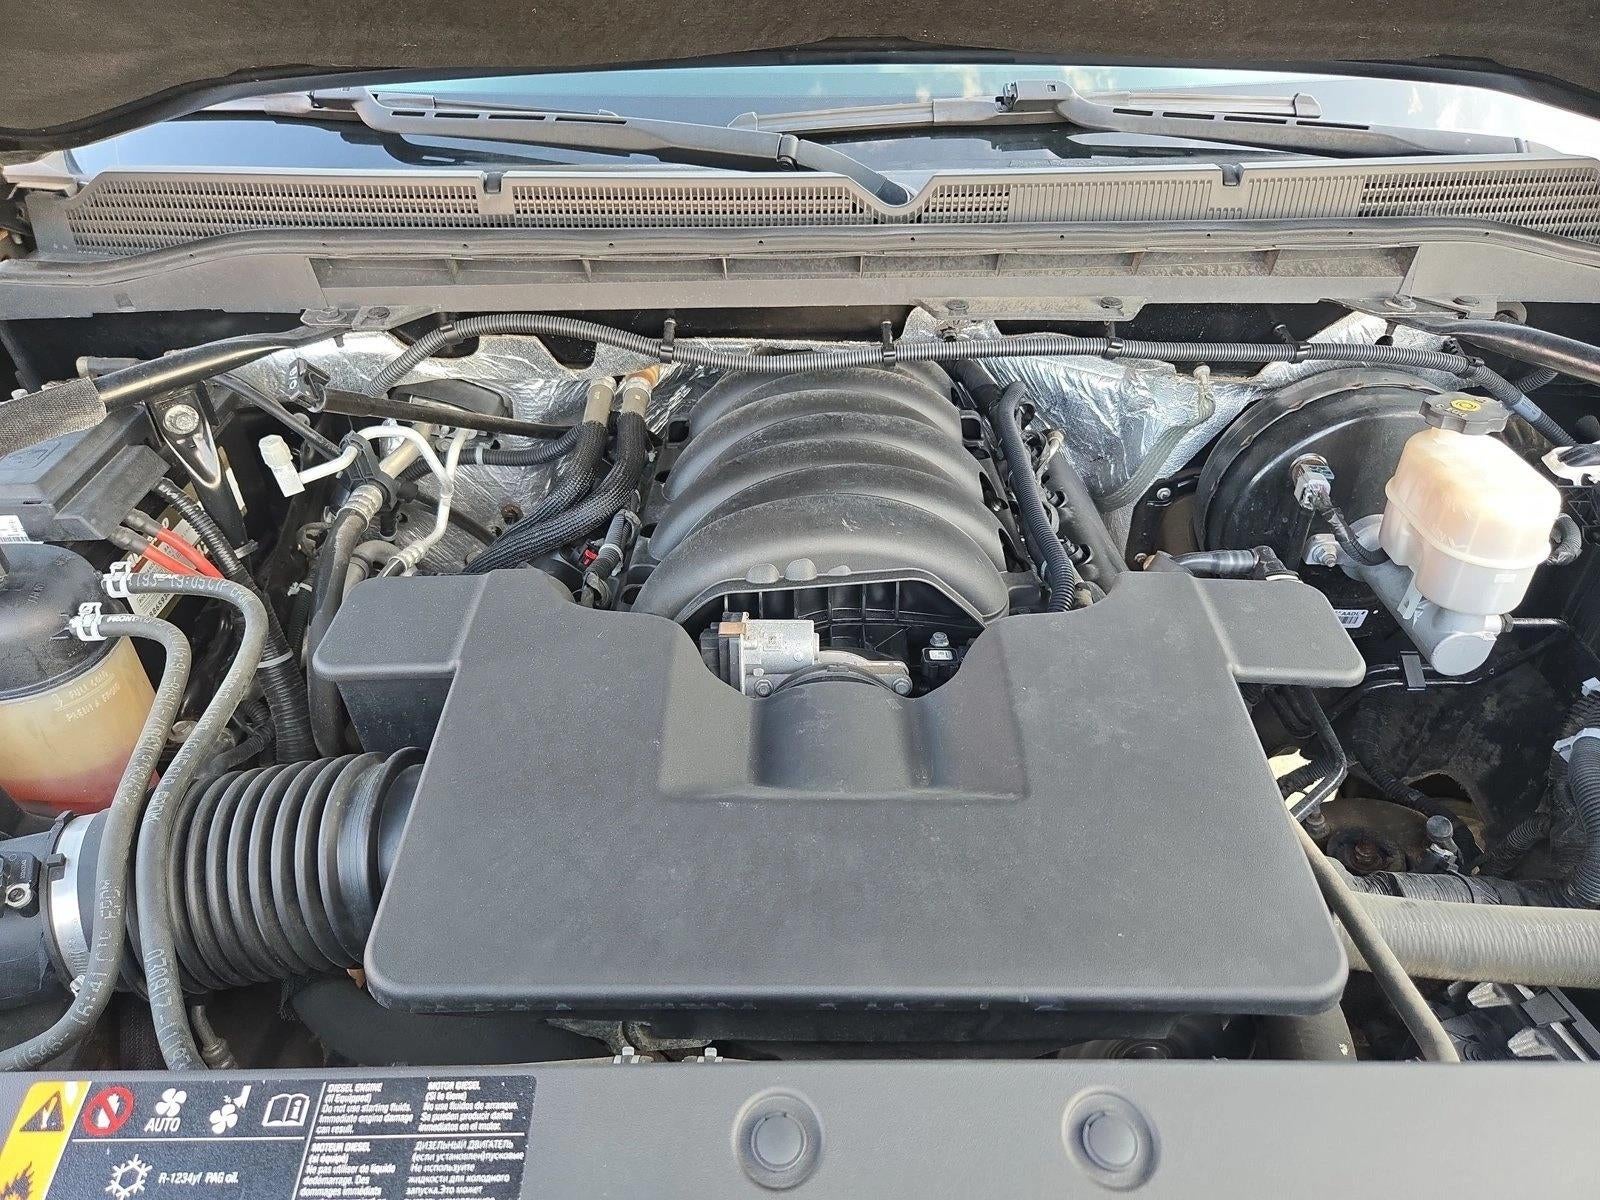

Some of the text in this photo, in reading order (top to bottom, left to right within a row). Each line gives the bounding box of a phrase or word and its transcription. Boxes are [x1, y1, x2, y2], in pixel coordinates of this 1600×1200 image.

[327, 1083, 353, 1093] DIESEL
[144, 1117, 181, 1133] AUTO
[158, 1171, 203, 1186] R-1234yf
[204, 1171, 225, 1184] PAG
